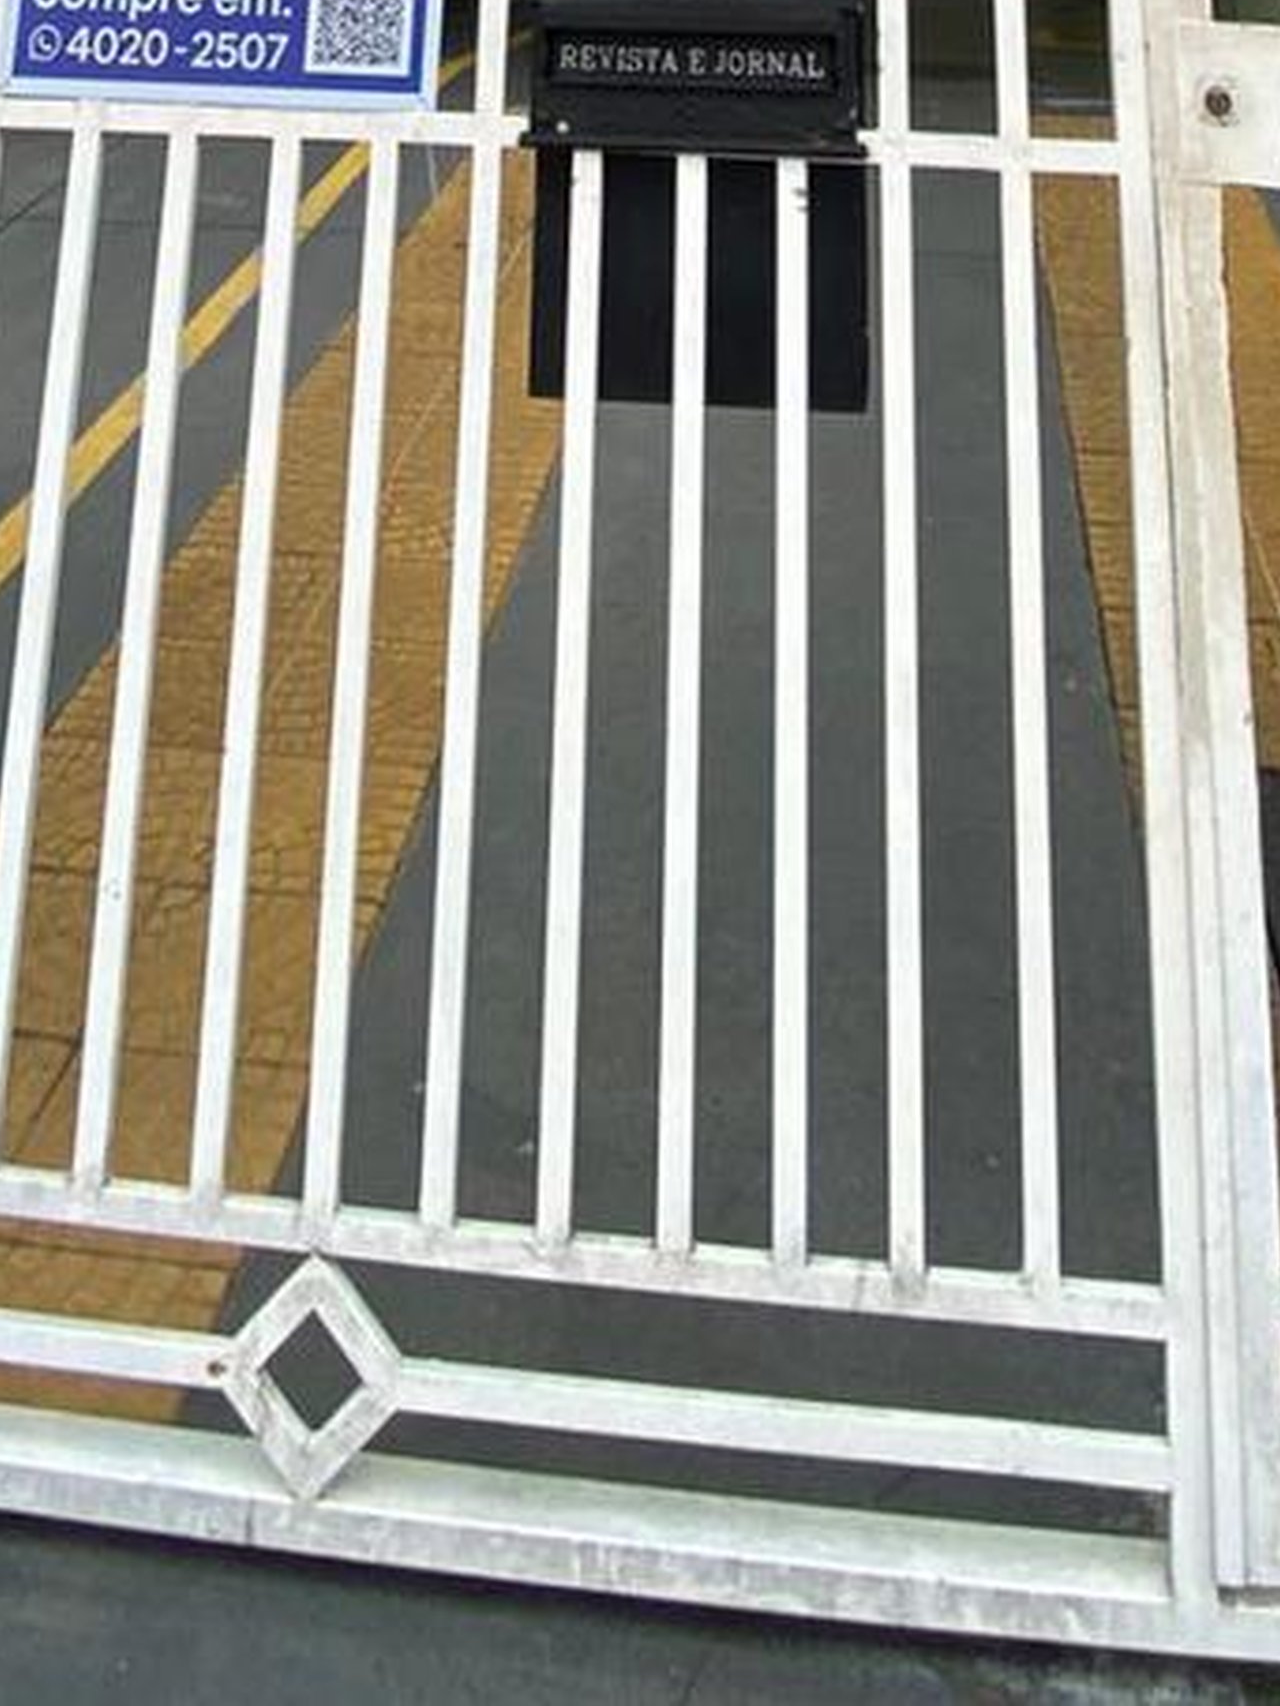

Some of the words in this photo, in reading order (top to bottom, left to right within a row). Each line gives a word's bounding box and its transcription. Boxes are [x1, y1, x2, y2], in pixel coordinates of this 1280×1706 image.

[66, 28, 289, 70] 4020-2507
[560, 43, 678, 74] REVISTA
[689, 46, 706, 75] E
[714, 49, 825, 80] JORNAL
